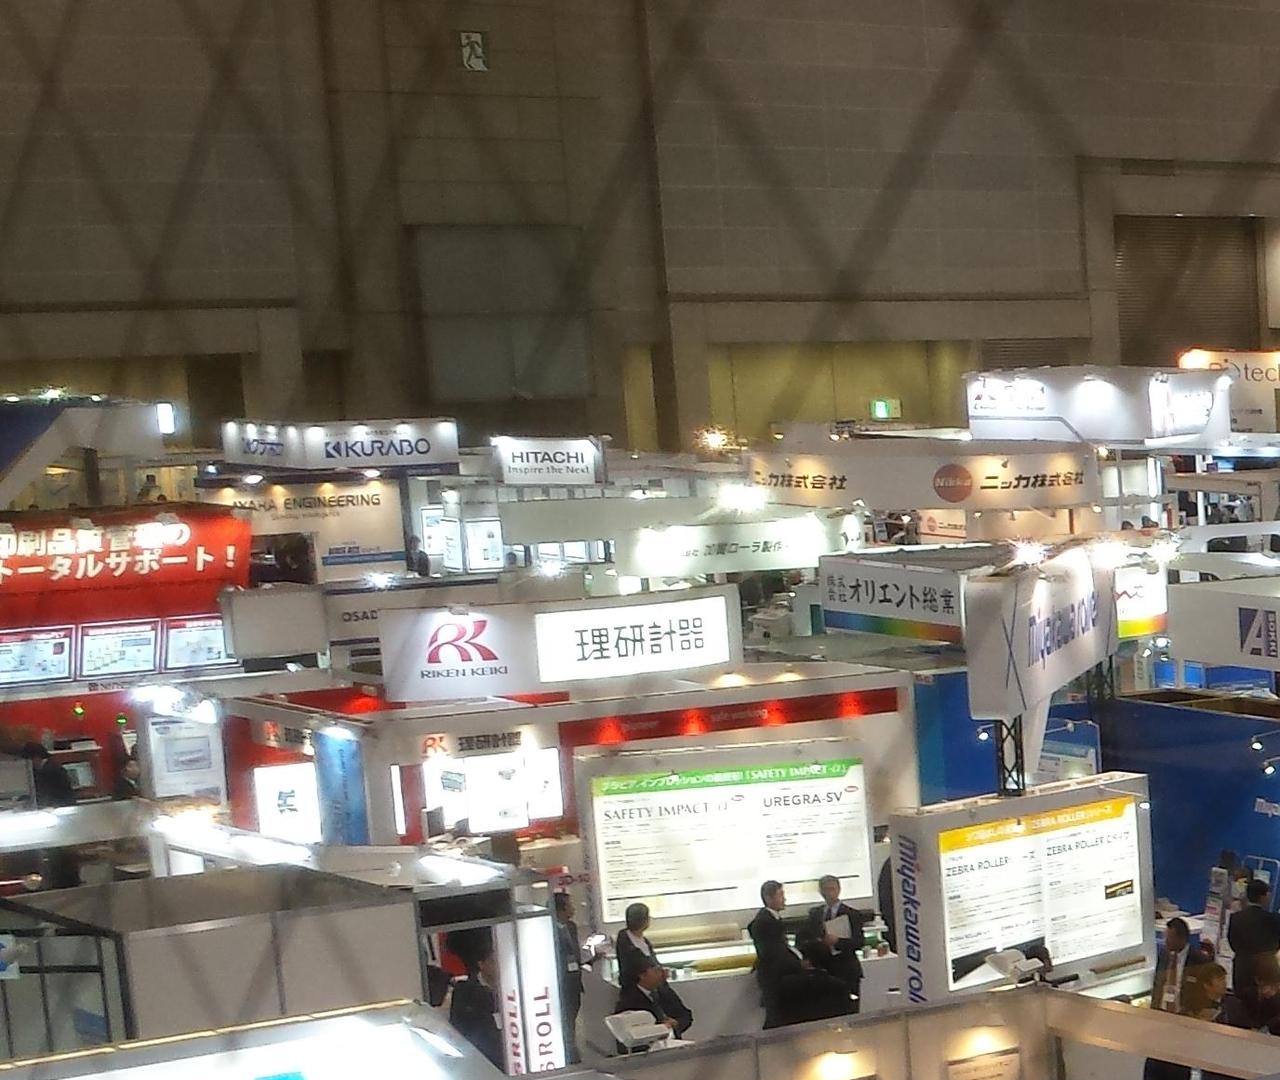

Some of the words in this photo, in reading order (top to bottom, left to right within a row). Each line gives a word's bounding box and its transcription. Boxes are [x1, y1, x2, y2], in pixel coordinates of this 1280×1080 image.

[344, 437, 431, 459] KURABO
[511, 450, 585, 465] HITACHI
[507, 464, 544, 476] Inspire
[979, 470, 1085, 490] ニッカ株式会社
[284, 493, 381, 510] ENGINEERING
[848, 578, 956, 616] オリエント総業
[576, 616, 705, 661] 理研計器
[421, 666, 466, 680] RIKEN
[470, 664, 509, 678] KEIKI
[763, 791, 844, 809] UREGRA-SV
[603, 804, 654, 822] SAFETY
[657, 801, 711, 818] IMPACT
[1046, 842, 1074, 857] ZEBRA
[946, 861, 976, 878] ZEBRA
